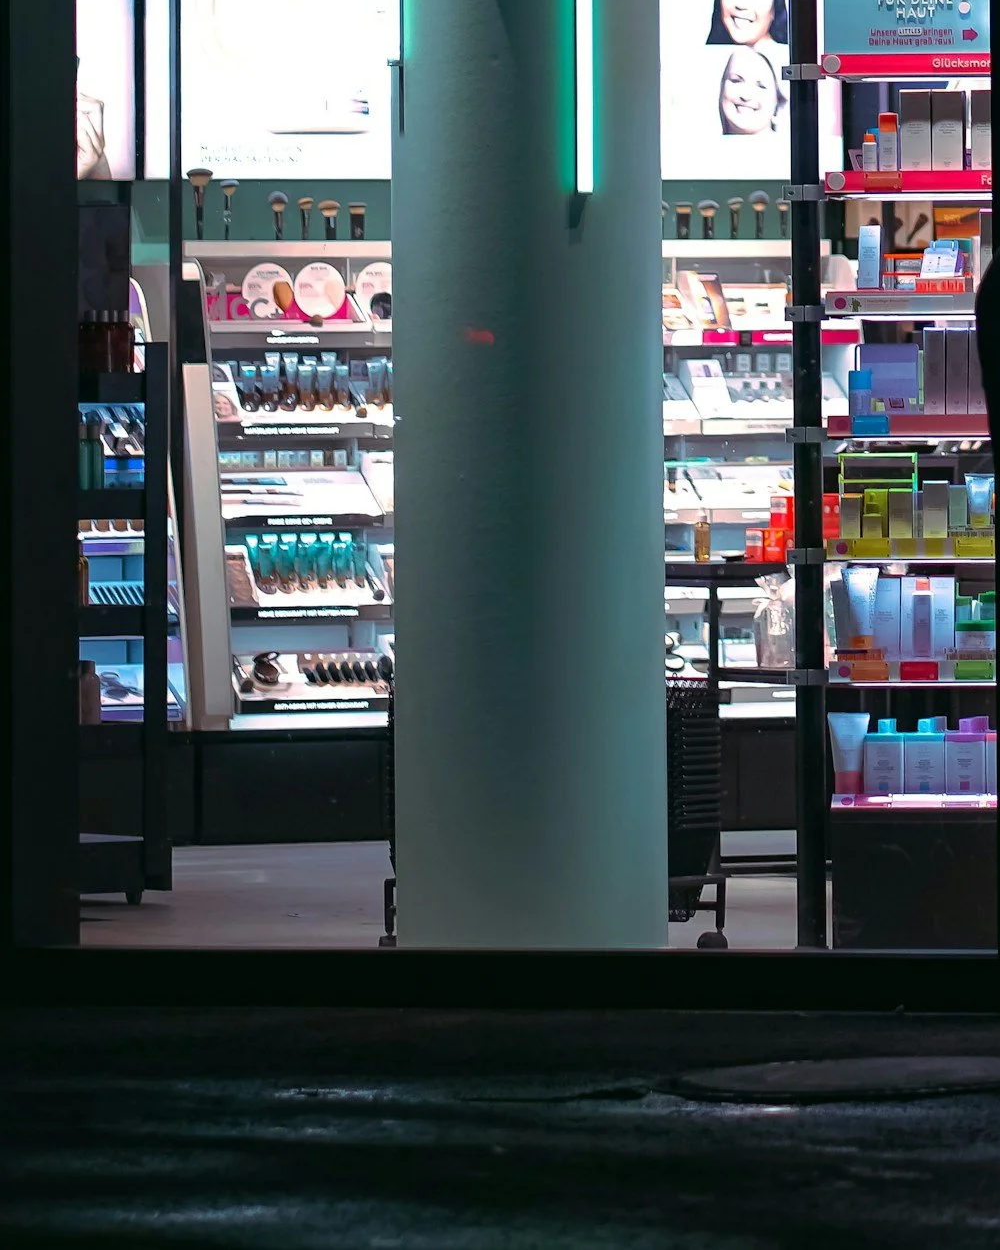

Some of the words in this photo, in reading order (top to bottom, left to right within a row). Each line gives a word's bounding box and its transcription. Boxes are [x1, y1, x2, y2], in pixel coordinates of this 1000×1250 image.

[896, 7, 935, 18] HAUT
[869, 37, 891, 46] Deine
[892, 38, 913, 46] Haut
